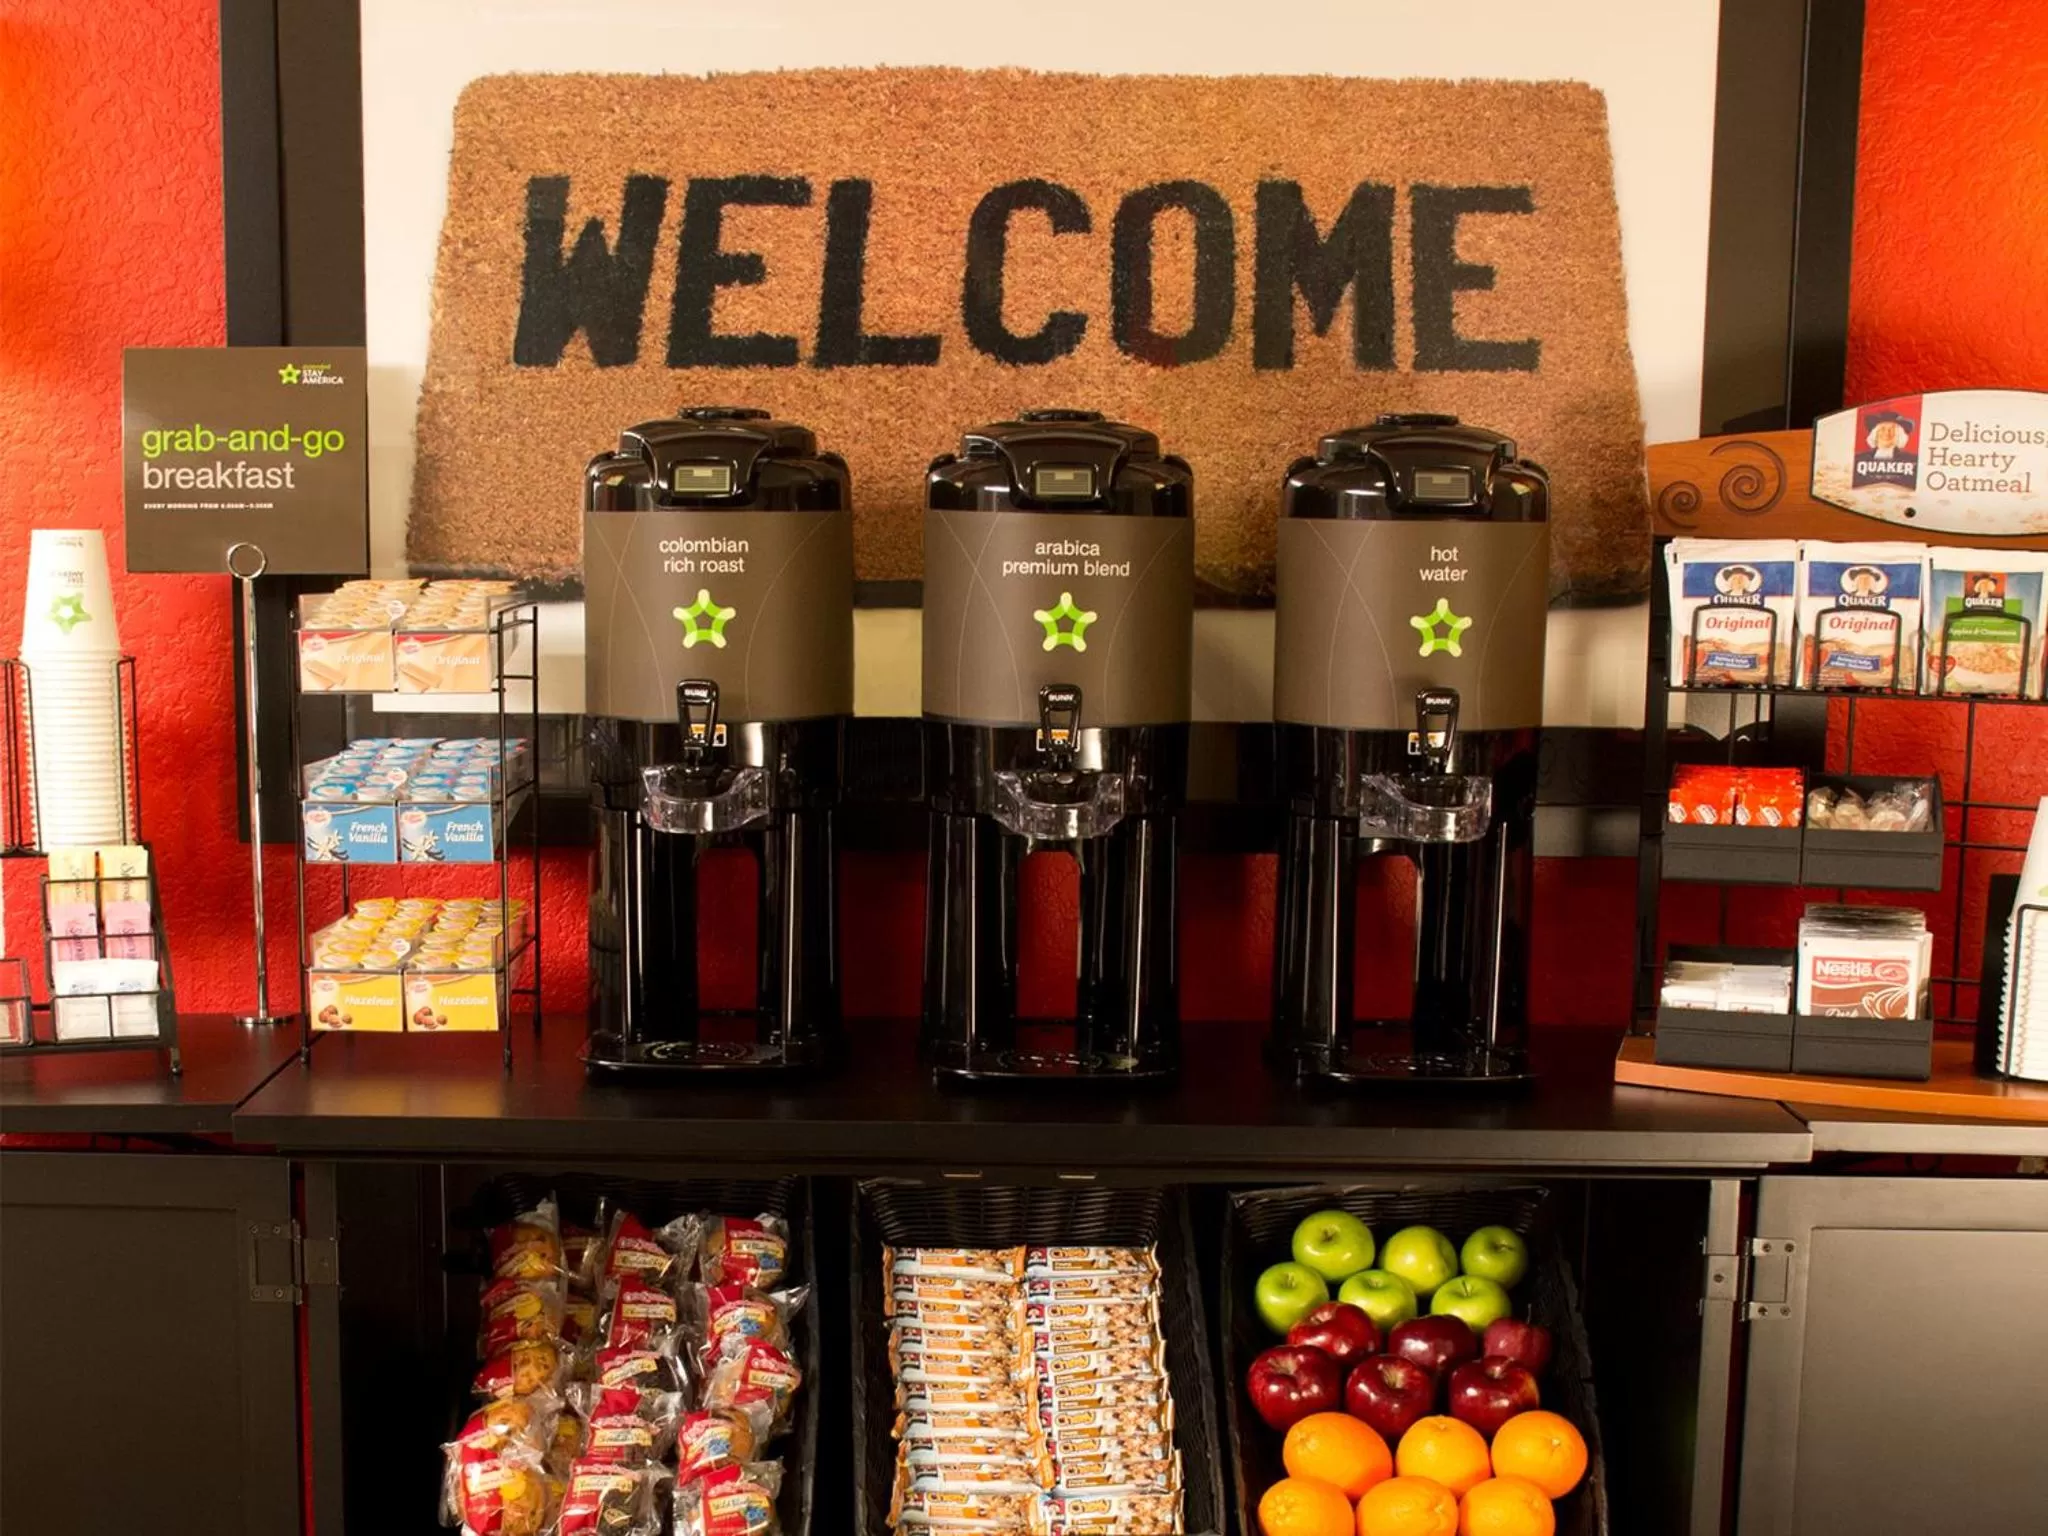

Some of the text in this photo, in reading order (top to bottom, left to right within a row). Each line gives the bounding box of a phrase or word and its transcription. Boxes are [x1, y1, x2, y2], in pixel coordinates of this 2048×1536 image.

[513, 172, 1541, 372] WELCOME
[303, 376, 344, 385] AMERICA
[142, 424, 344, 458] grab-and-go
[1857, 460, 1914, 476] QUAKER
[1927, 447, 2016, 474] Hearty
[143, 461, 295, 489] breakfast
[1926, 470, 2032, 494] Oatmeal
[659, 537, 749, 554] colombian
[1035, 540, 1100, 557] arabica
[1430, 546, 1459, 562] hot
[664, 556, 745, 573] rich roast
[1002, 560, 1131, 577] premium blend
[1419, 567, 1468, 582] water
[1839, 594, 1887, 607] QUAKER
[1965, 598, 2003, 608] QUAKER
[1705, 616, 1771, 632] Original
[1829, 617, 1898, 633] Original
[1048, 694, 1074, 702] BUNN
[350, 821, 388, 833] French
[446, 821, 484, 832] French
[349, 832, 388, 844] Vanilla
[444, 831, 485, 842] Vanilla
